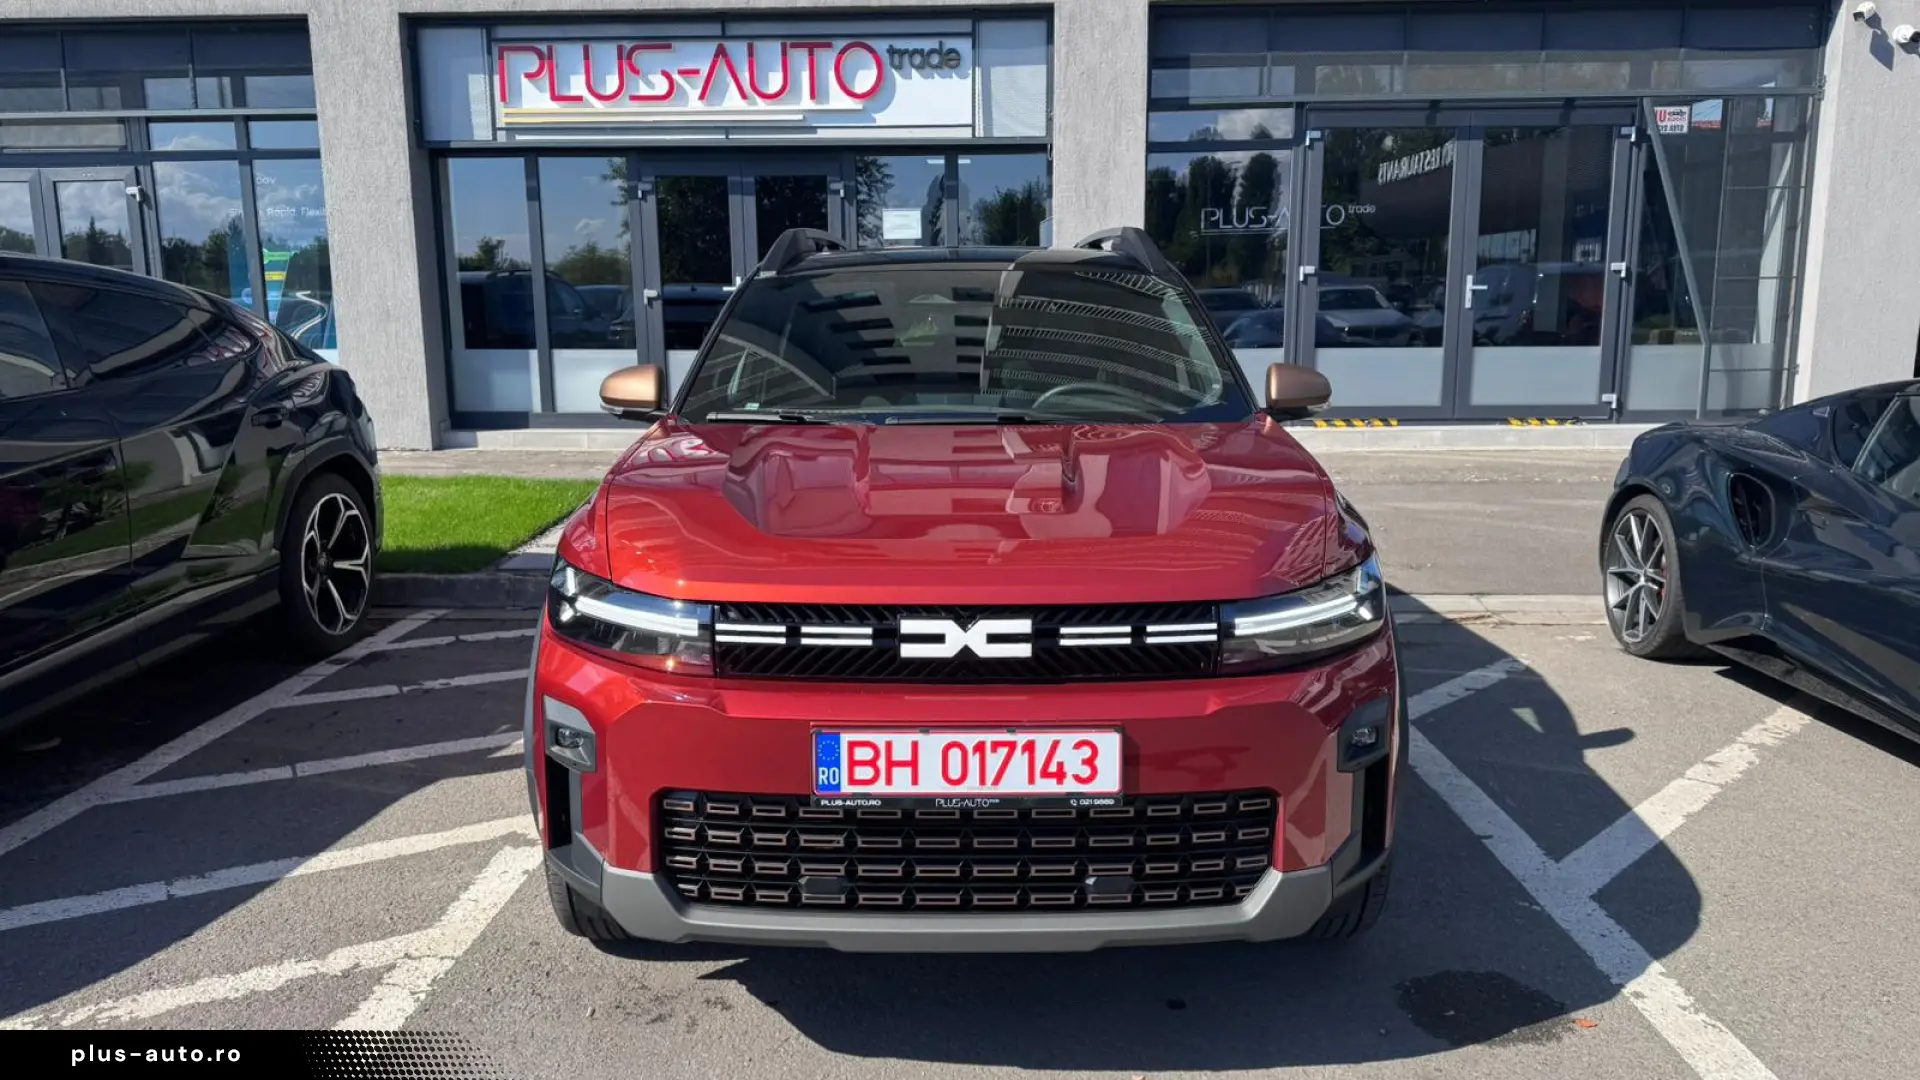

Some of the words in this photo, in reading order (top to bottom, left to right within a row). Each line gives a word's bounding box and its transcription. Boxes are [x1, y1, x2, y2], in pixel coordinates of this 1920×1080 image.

[498, 41, 884, 103] PLUS-AUTO
[886, 40, 961, 70] trade
[1348, 204, 1376, 214] trade
[819, 767, 840, 786] RO
[847, 740, 919, 786] BH
[941, 740, 1099, 786] 017143
